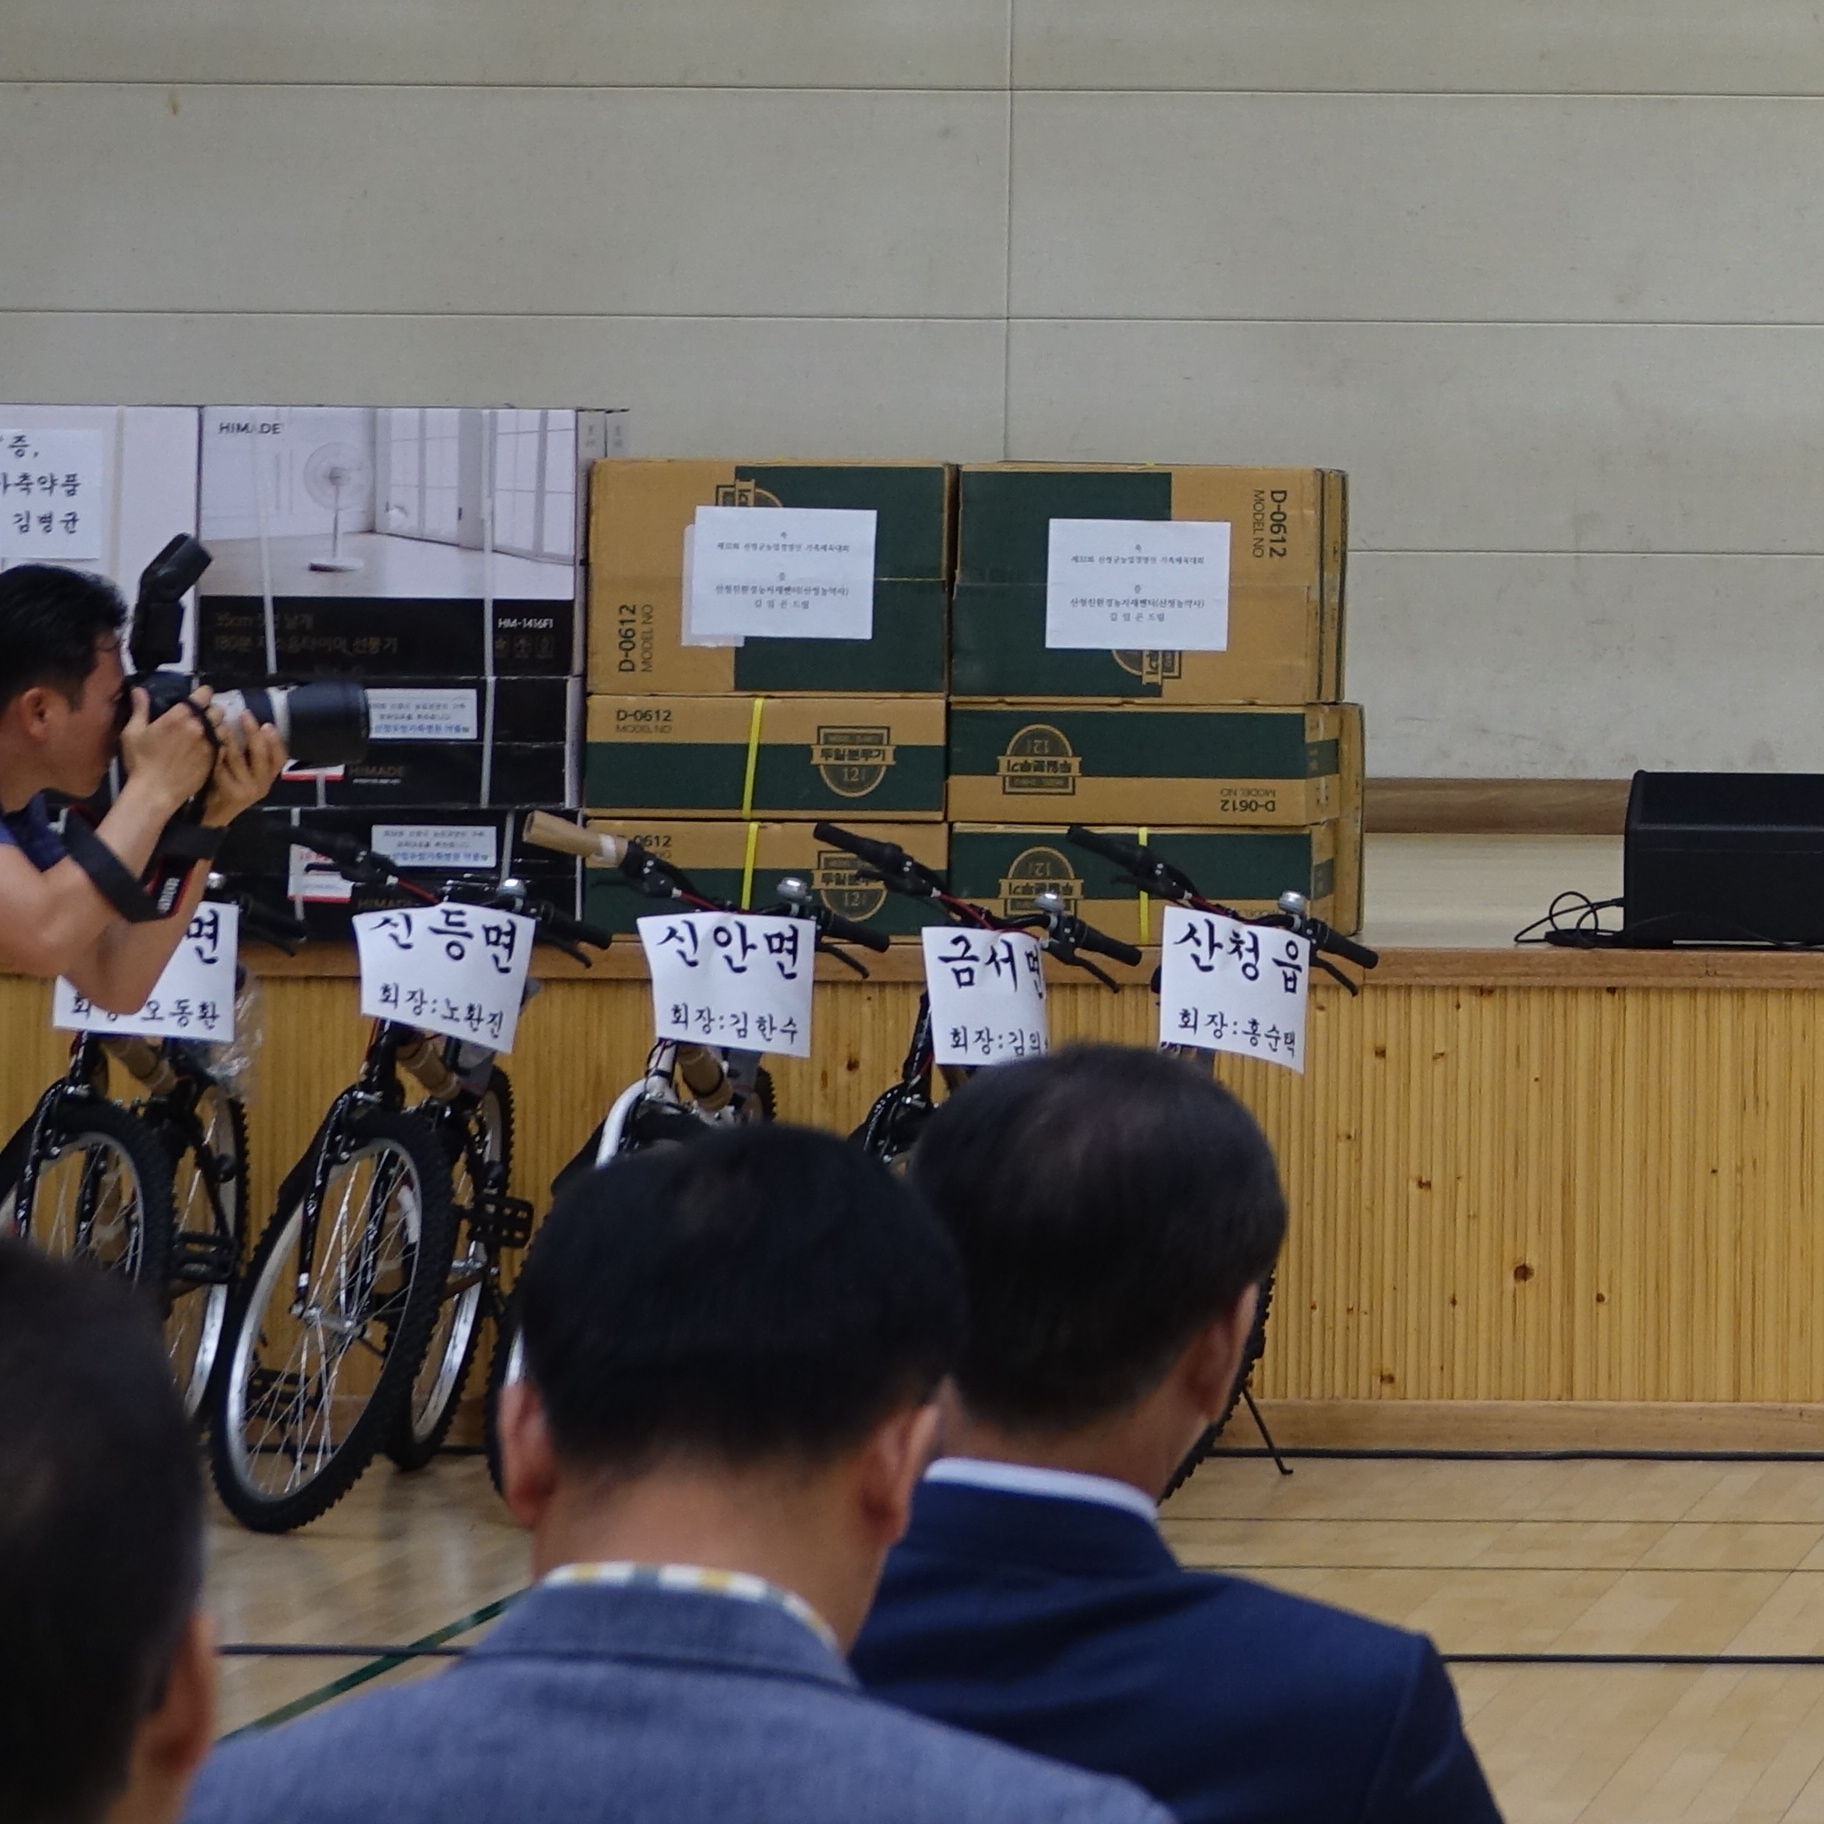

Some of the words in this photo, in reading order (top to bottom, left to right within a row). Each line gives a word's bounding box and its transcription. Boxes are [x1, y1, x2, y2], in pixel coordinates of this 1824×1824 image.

[218, 422, 280, 435] HIMDE
[1269, 489, 1288, 559] D-0612
[619, 603, 637, 673] D-0612
[616, 709, 673, 722] D-0612
[1220, 798, 1276, 813] D-0612
[370, 908, 518, 974] 신등면
[656, 919, 800, 981] 신안면
[938, 934, 1046, 1000] 금서면
[1173, 918, 1303, 995] 산청읍
